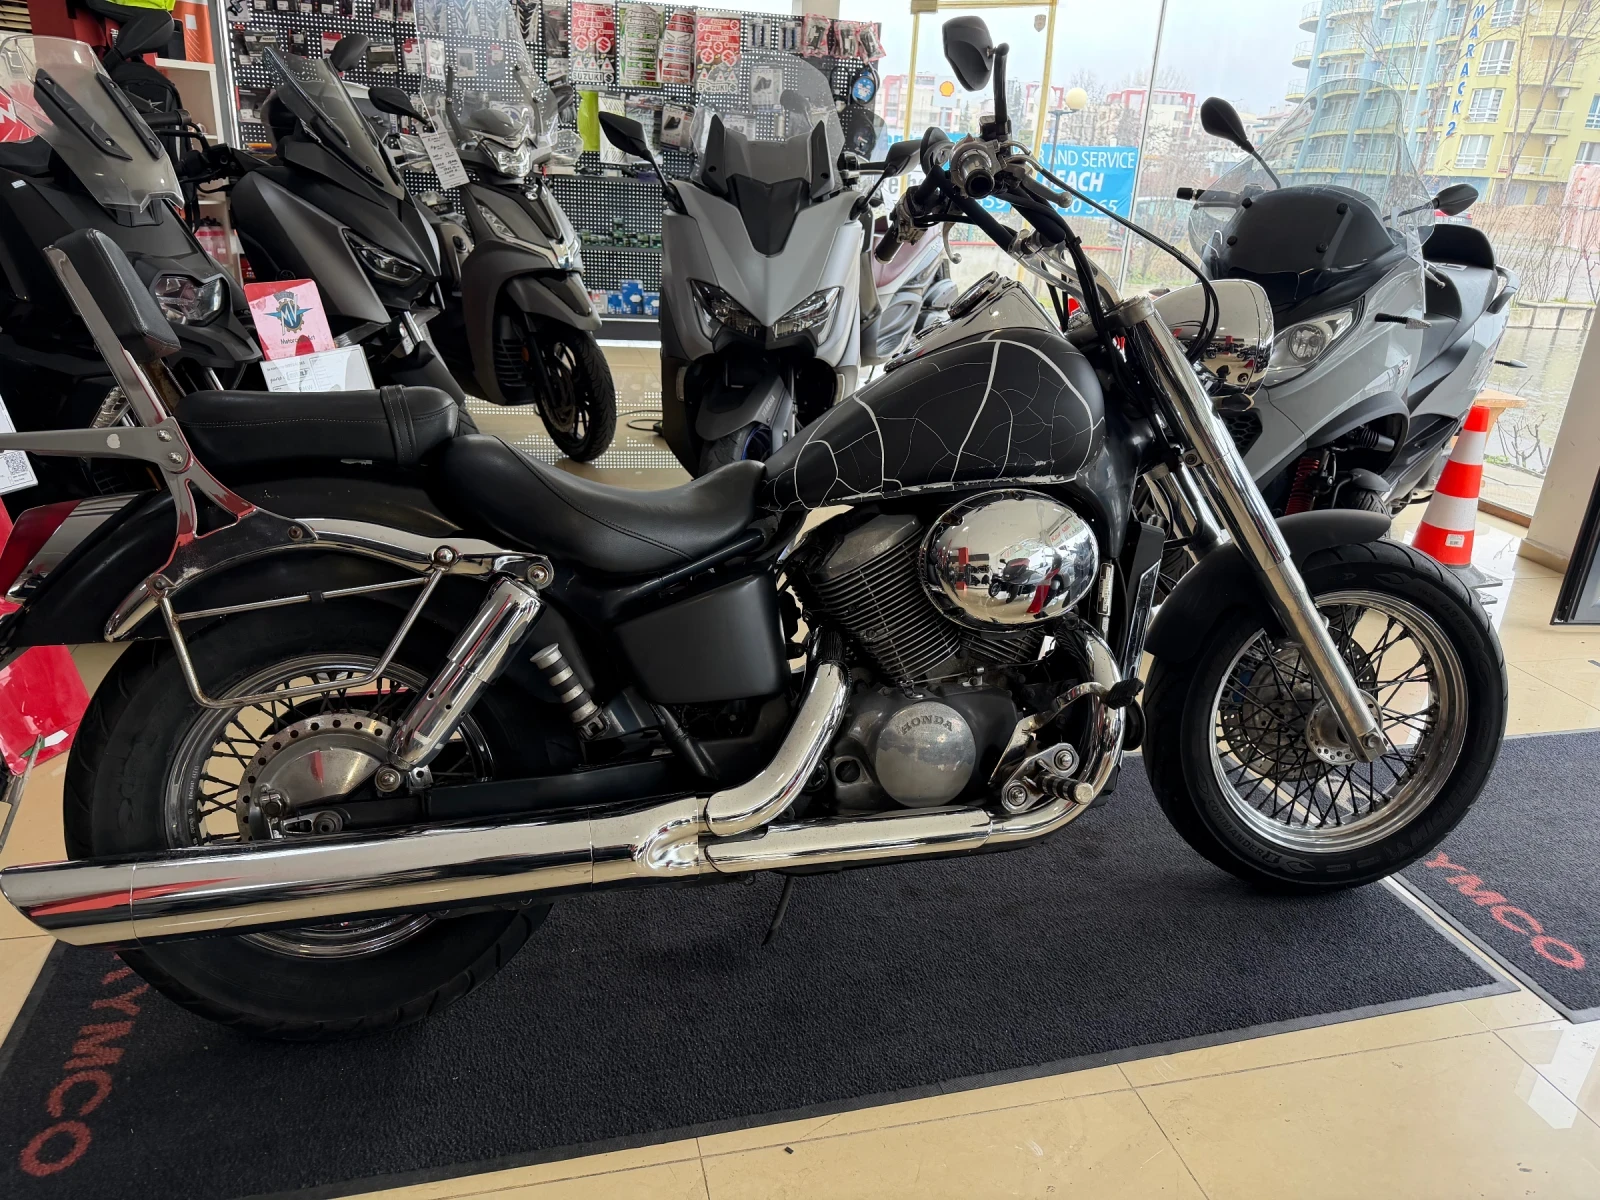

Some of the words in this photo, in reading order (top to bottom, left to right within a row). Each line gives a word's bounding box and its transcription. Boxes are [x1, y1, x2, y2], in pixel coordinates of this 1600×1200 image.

[572, 72, 603, 81] SUZUKI
[1048, 149, 1079, 166] AND
[1081, 151, 1136, 169] SERVICE
[901, 714, 953, 735] HONDA
[1207, 798, 1265, 857] COMMANDER
[1424, 852, 1586, 970] YMCO
